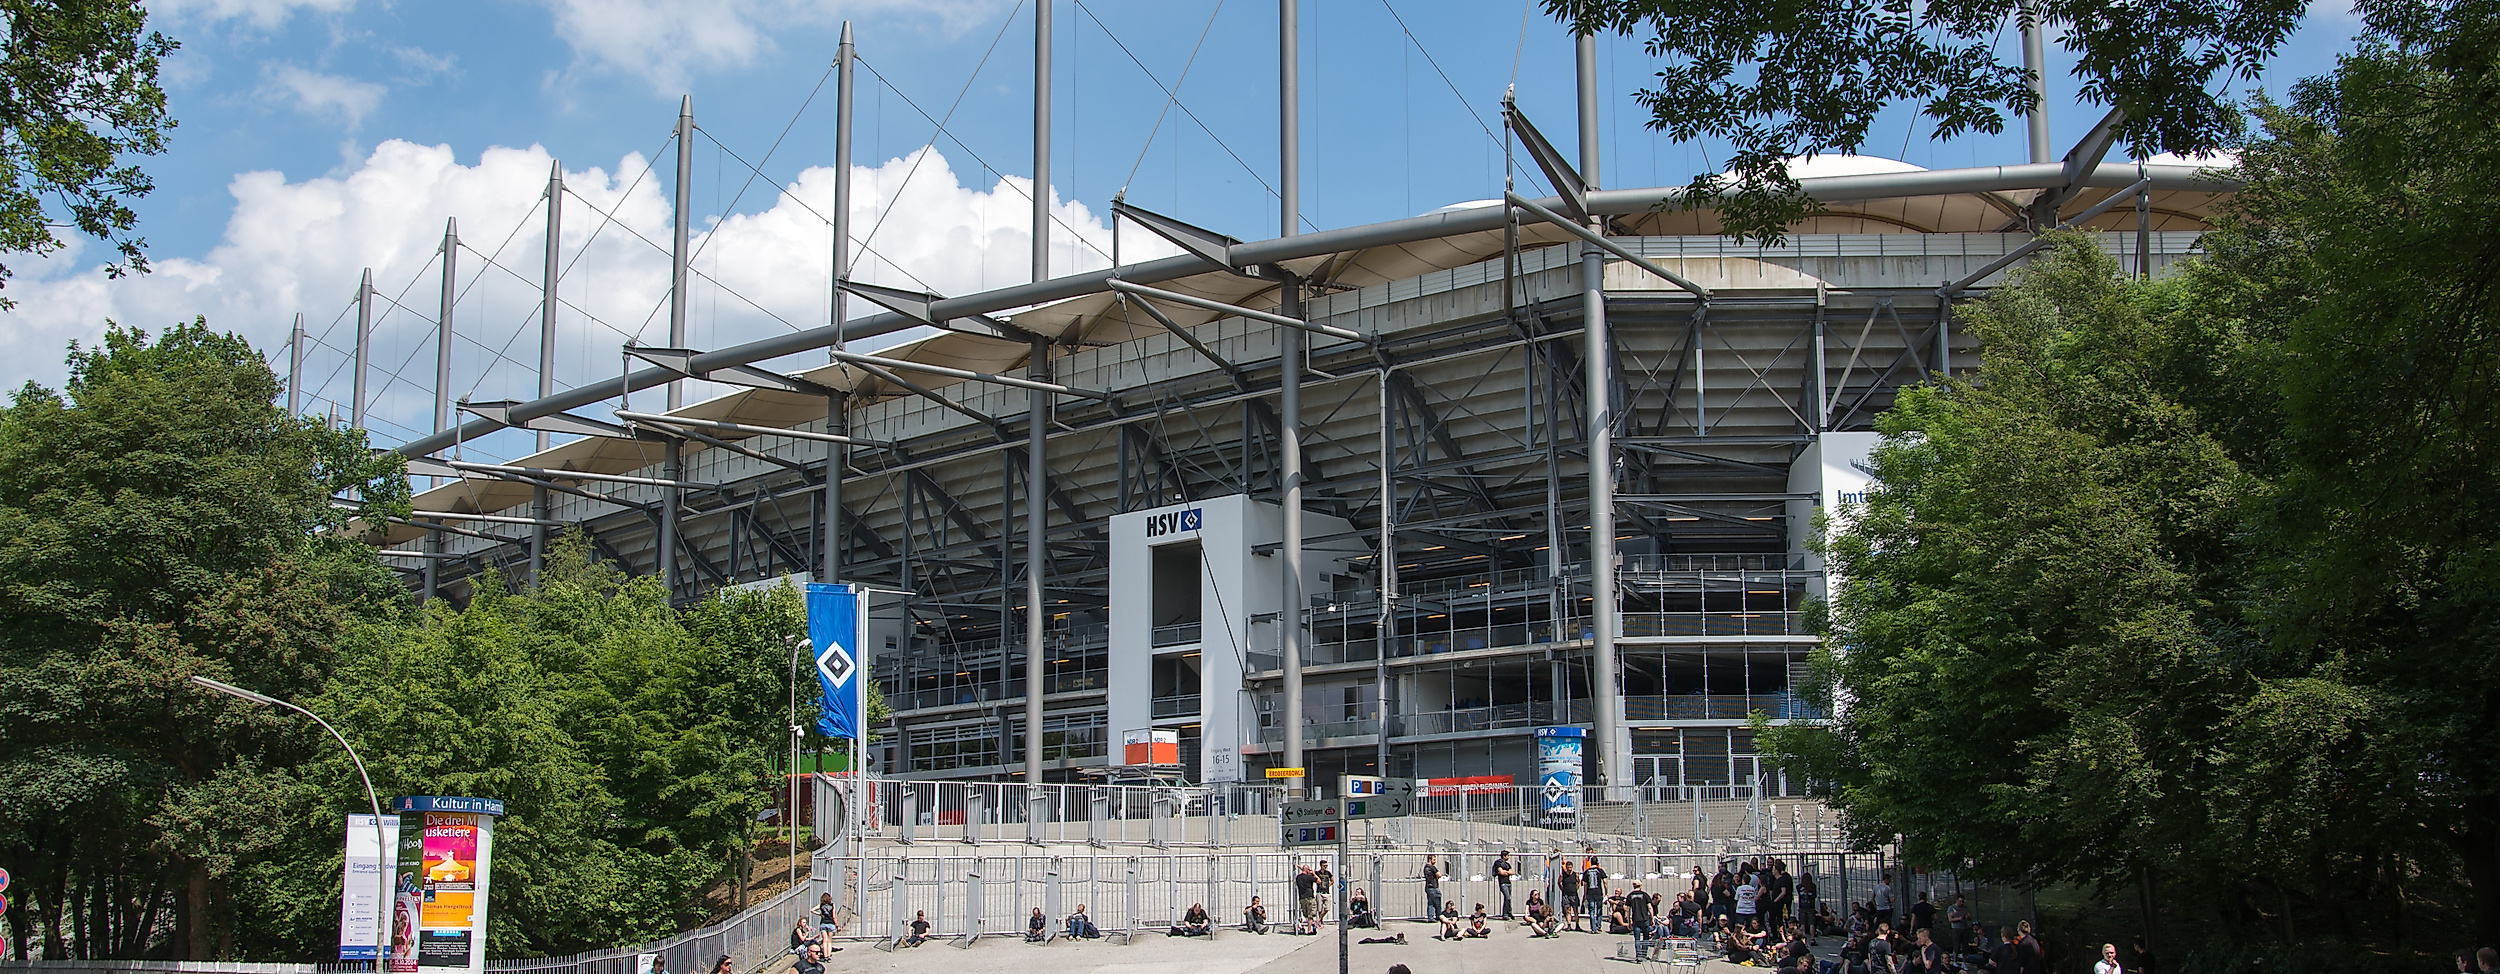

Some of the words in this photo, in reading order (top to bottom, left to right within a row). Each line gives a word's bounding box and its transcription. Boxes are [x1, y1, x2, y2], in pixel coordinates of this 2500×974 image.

[1146, 511, 1179, 537] HSV
[1538, 728, 1548, 736] HSV
[1212, 754, 1230, 764] 16-15
[1353, 781, 1361, 792] P
[1376, 782, 1383, 793] P
[432, 797, 470, 810] Kultur
[472, 798, 482, 810] in
[1349, 803, 1357, 815] P
[426, 814, 443, 826] Die
[444, 815, 465, 826] drei
[466, 816, 477, 826] M
[425, 826, 471, 837] usketiere
[1301, 829, 1308, 840] P
[1319, 828, 1327, 840] P
[352, 862, 377, 870] Eingang
